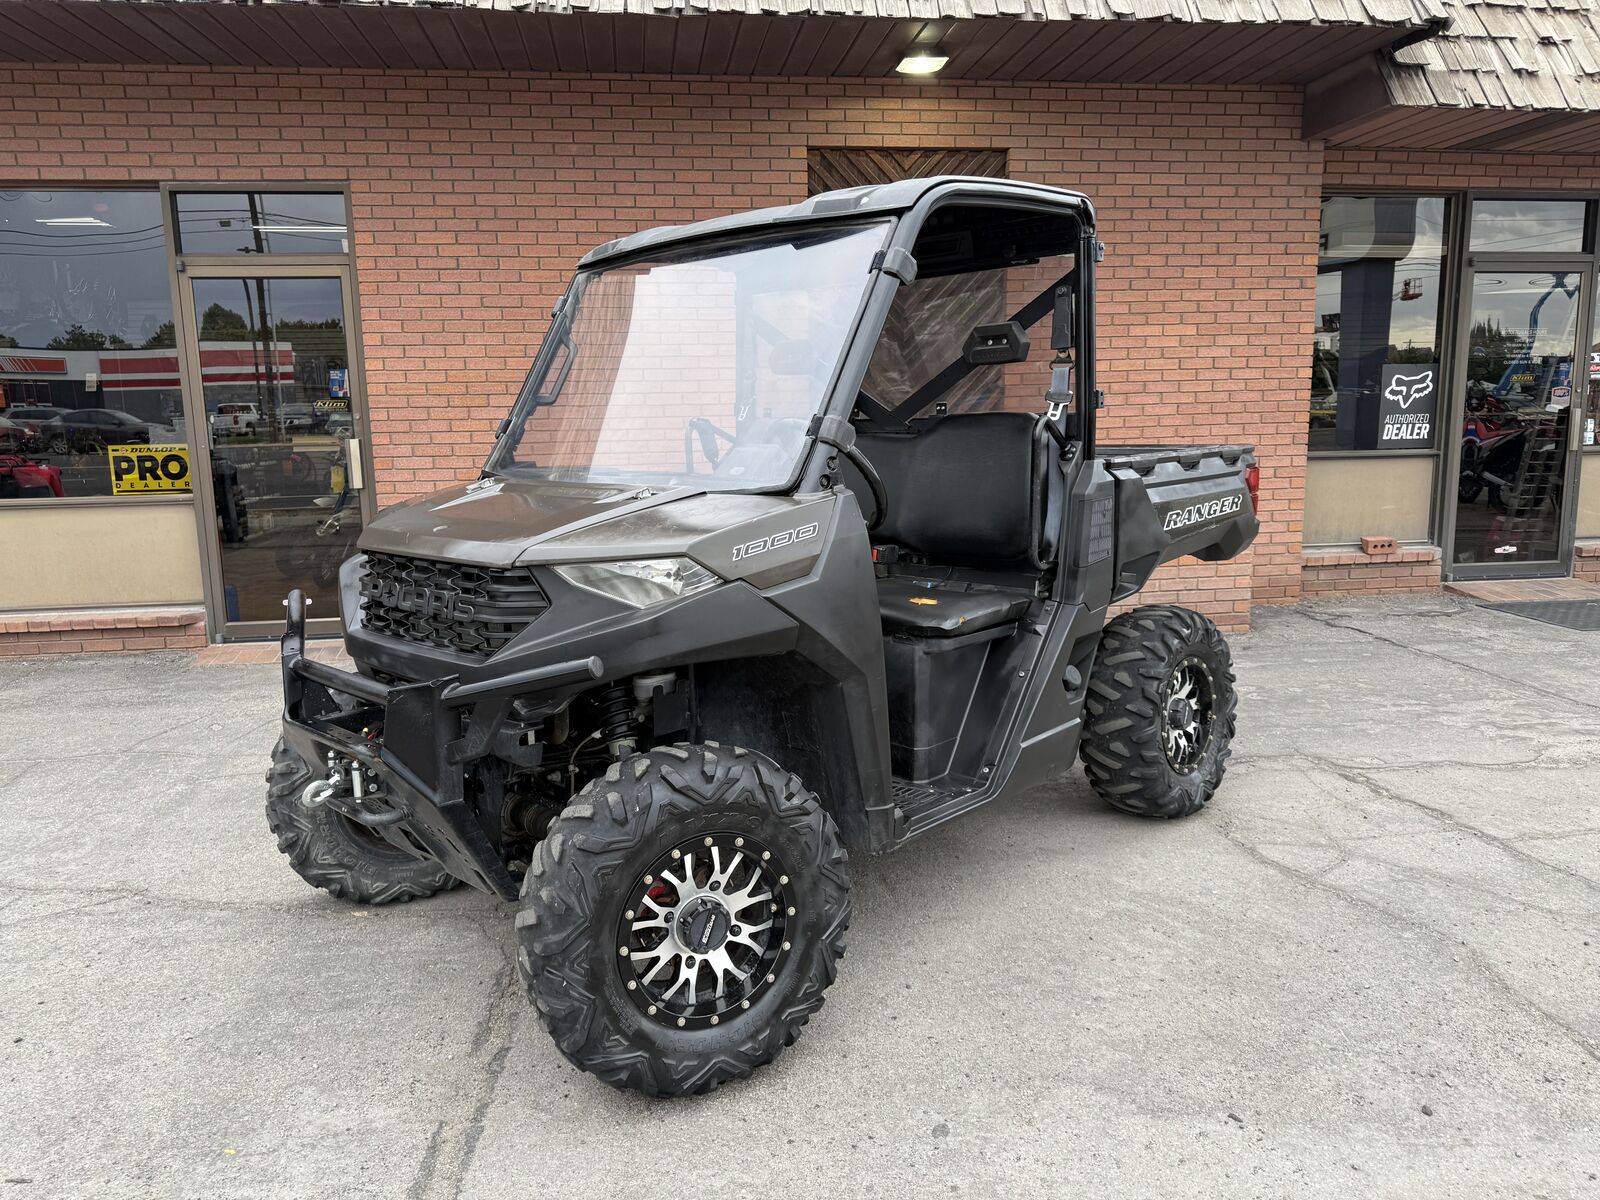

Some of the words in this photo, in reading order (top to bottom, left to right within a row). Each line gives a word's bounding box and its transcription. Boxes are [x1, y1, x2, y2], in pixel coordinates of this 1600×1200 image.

[1512, 374, 1533, 382] Klim
[1383, 413, 1430, 424] AUTHORIZED
[1382, 423, 1430, 440] DEALER
[112, 453, 189, 482] PRO
[115, 481, 190, 489] DEALER
[1163, 494, 1242, 531] RANGER
[732, 521, 819, 562] 1000
[367, 578, 475, 623] POLARIS
